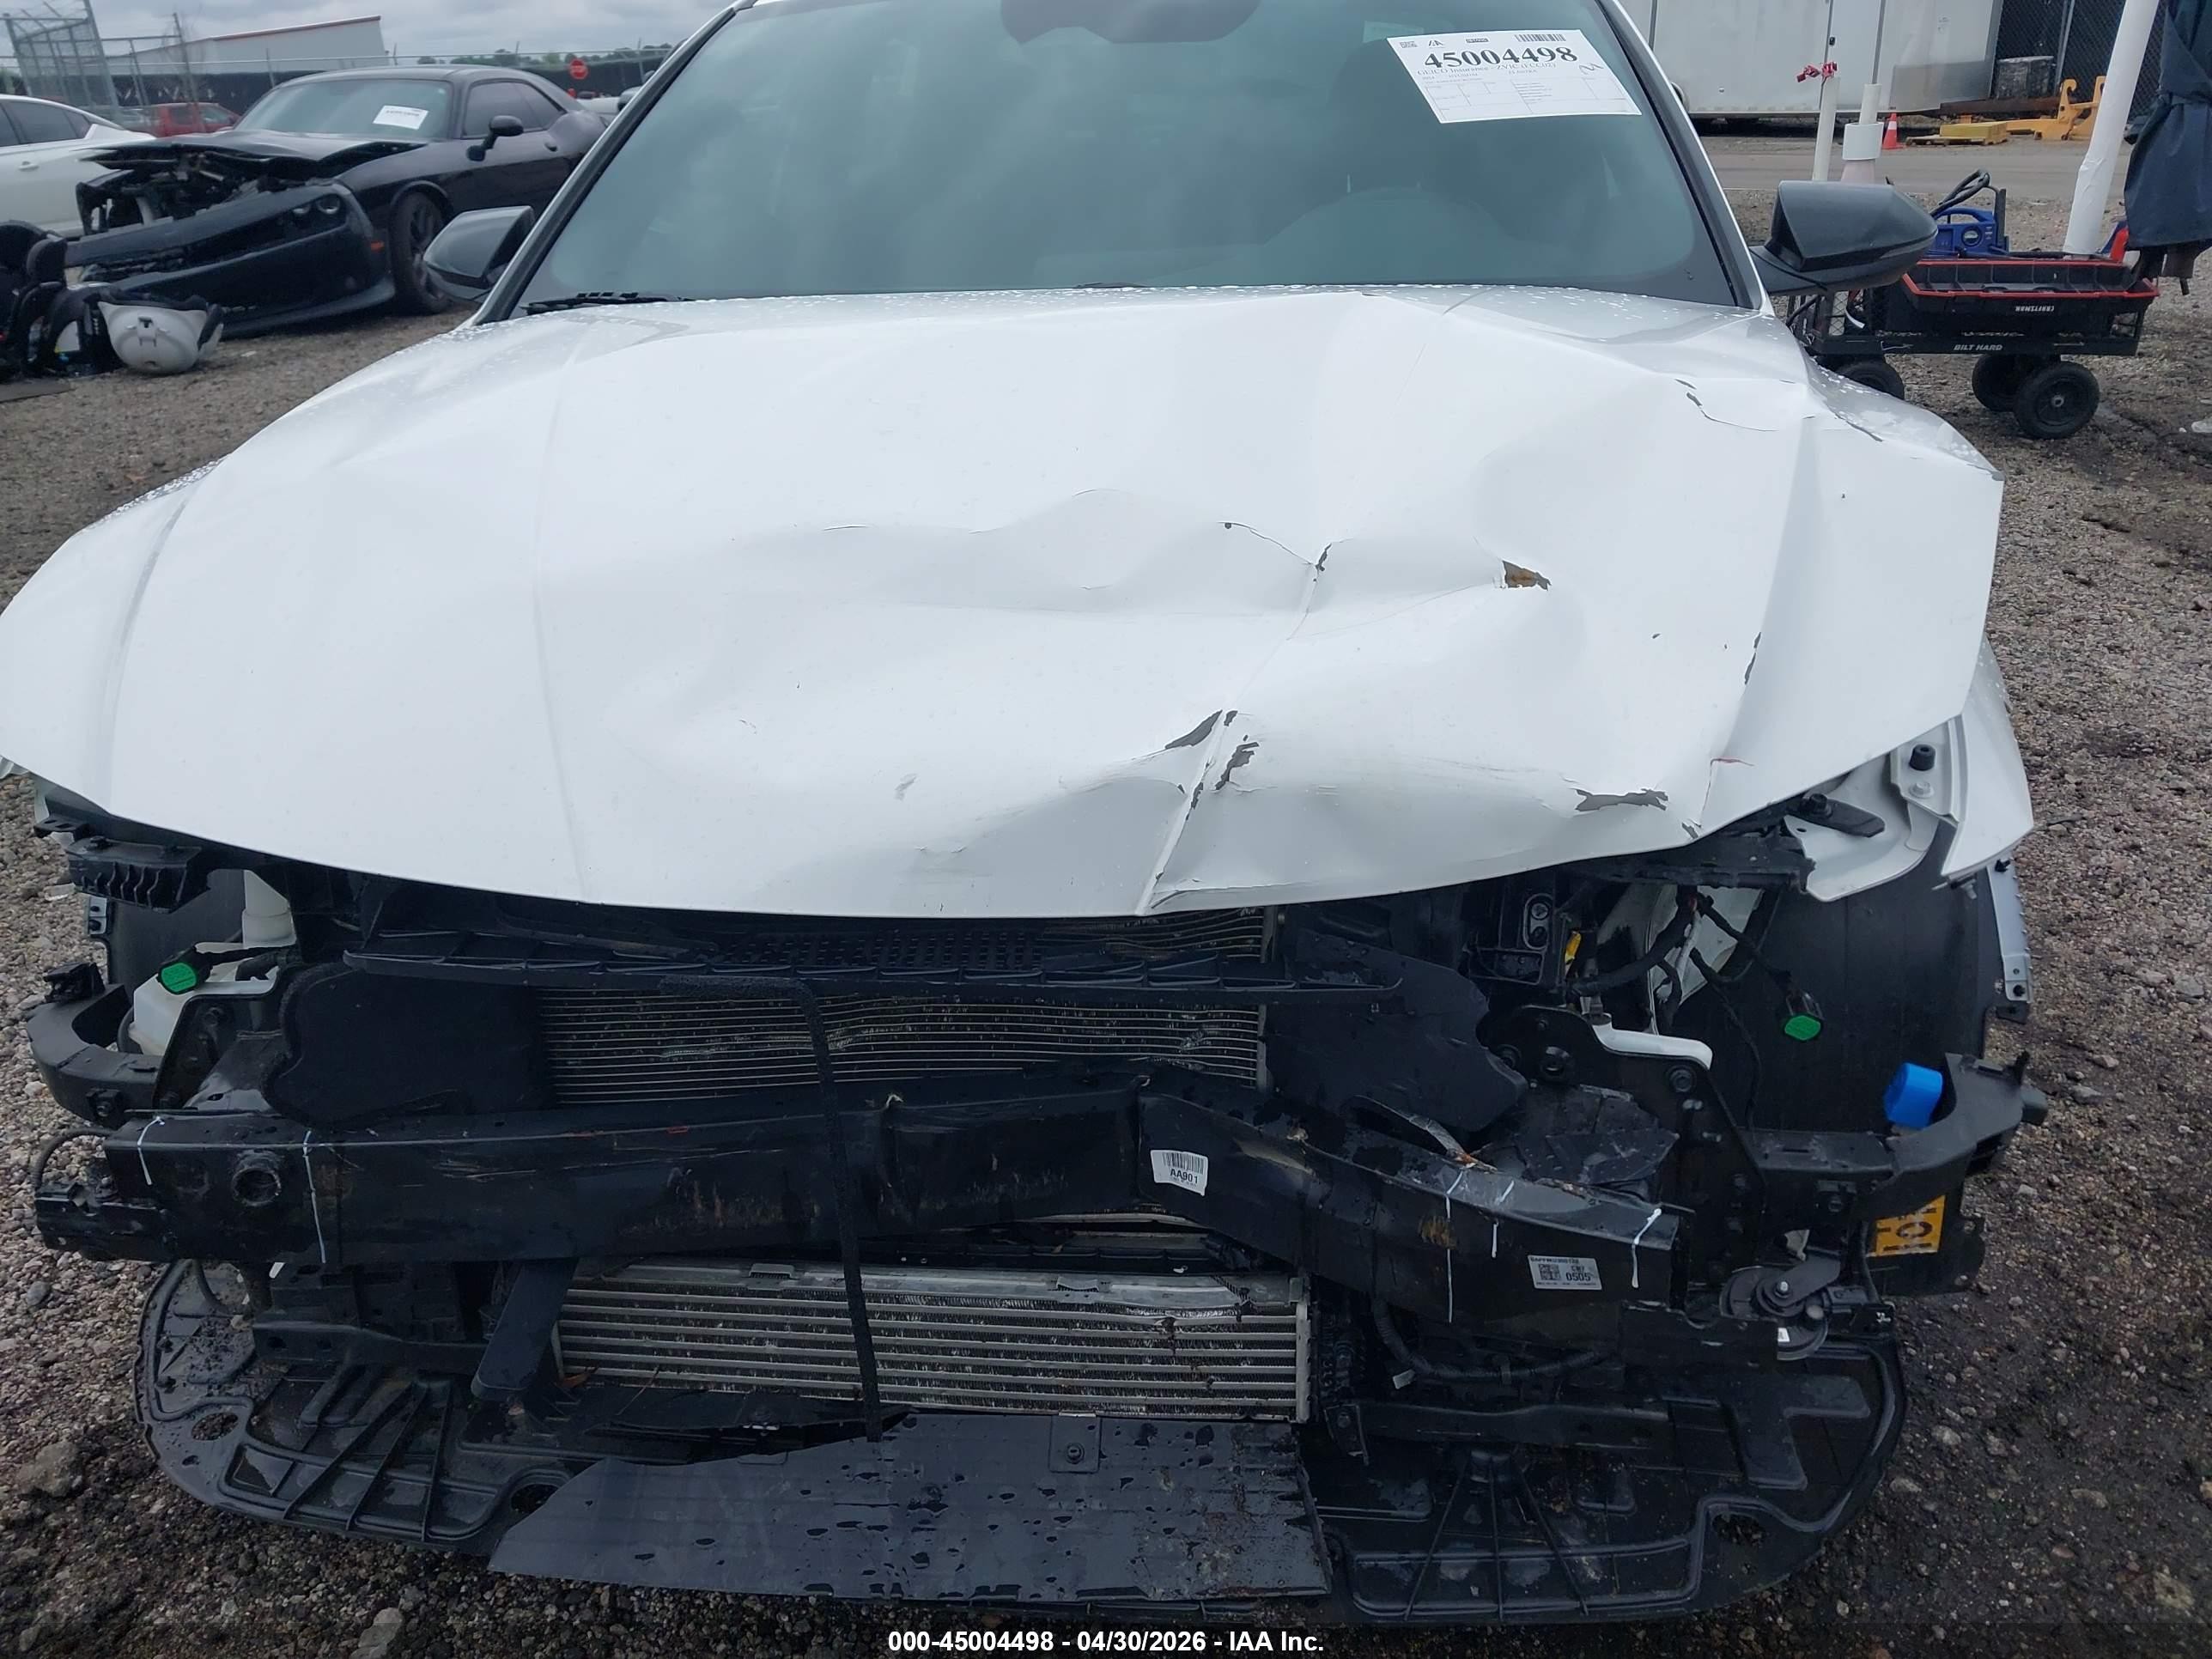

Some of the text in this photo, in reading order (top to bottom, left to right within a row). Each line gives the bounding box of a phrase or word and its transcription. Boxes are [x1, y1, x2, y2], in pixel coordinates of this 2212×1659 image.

[1425, 46, 1577, 69] 45004498
[1170, 1169, 1198, 1183] AA901
[1565, 1272, 1591, 1282] 0505
